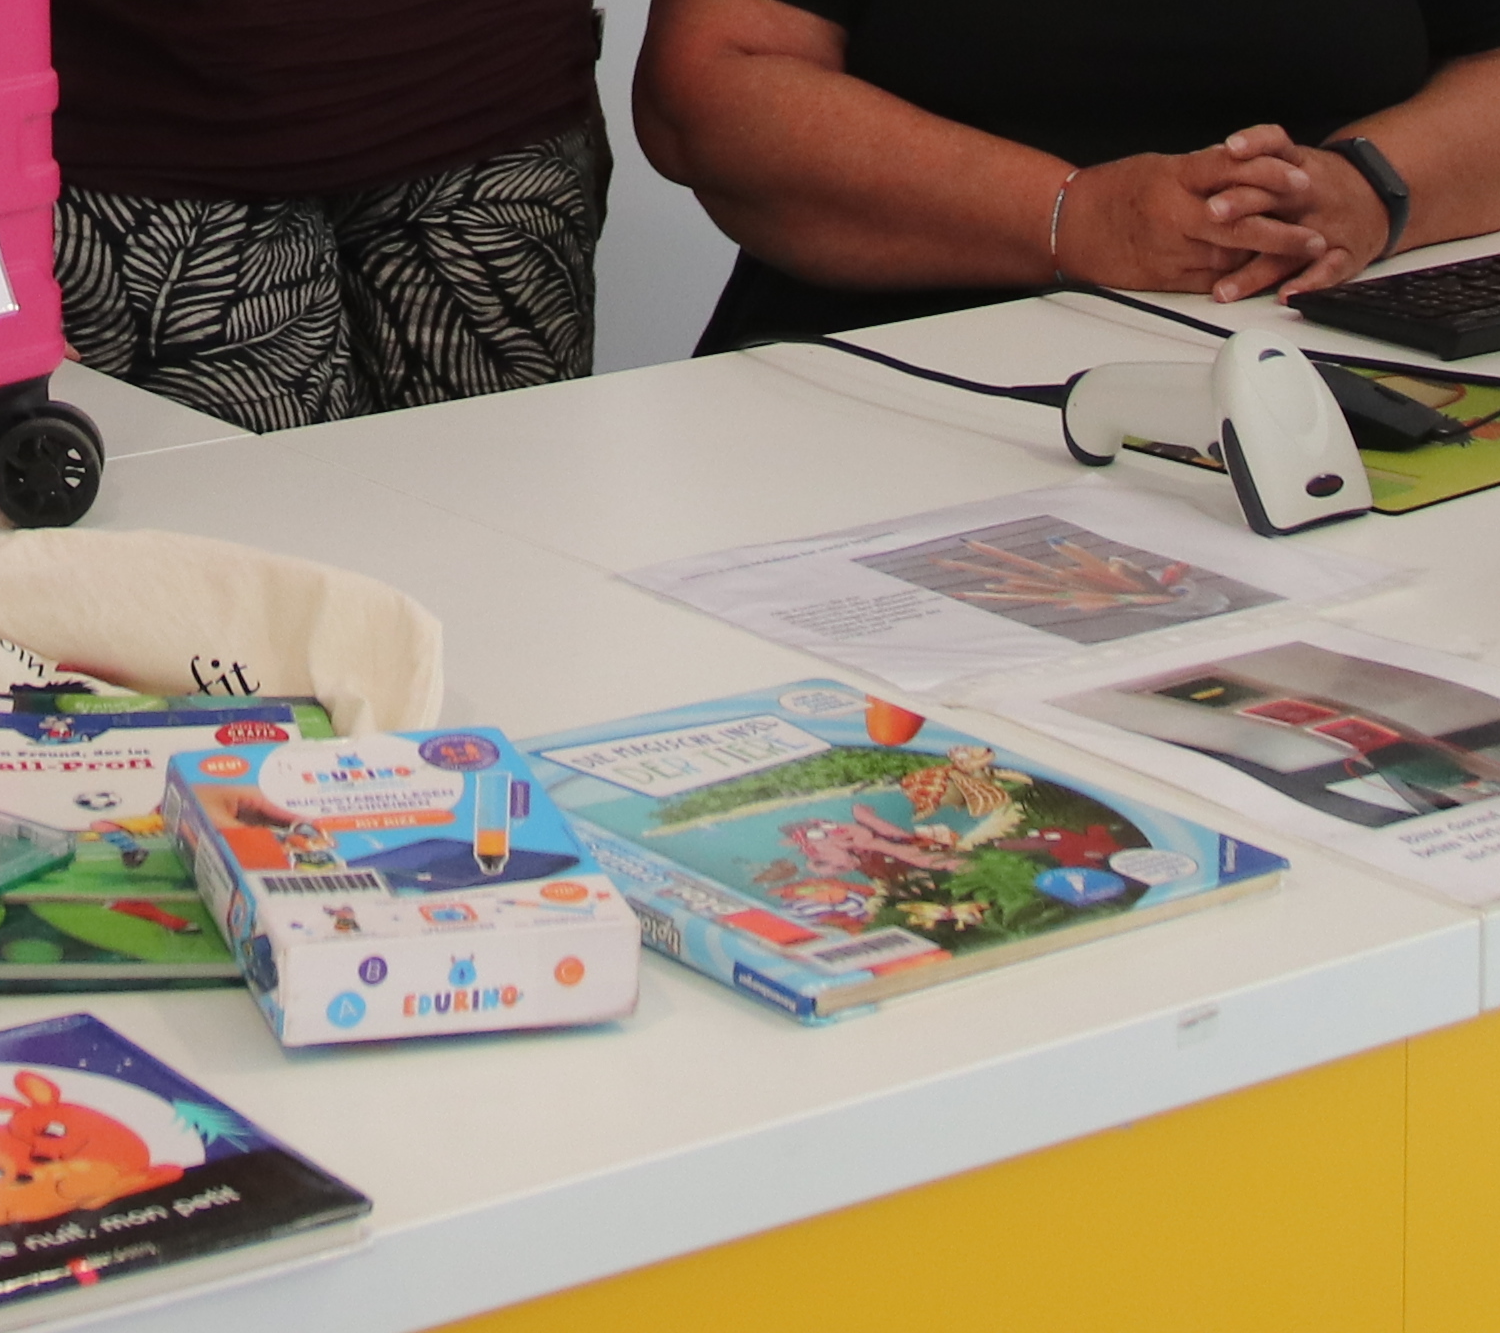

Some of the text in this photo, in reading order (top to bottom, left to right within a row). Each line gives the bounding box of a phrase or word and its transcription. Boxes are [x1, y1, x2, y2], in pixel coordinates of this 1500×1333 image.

[93, 745, 125, 757] der
[128, 745, 152, 756] ist
[614, 732, 718, 761] MAGISCHE
[302, 767, 415, 784] EDURINO
[402, 984, 522, 1018] EDURINO
[25, 1222, 96, 1254] nuit,
[101, 1206, 169, 1235] mon
[172, 1184, 243, 1219] petit
